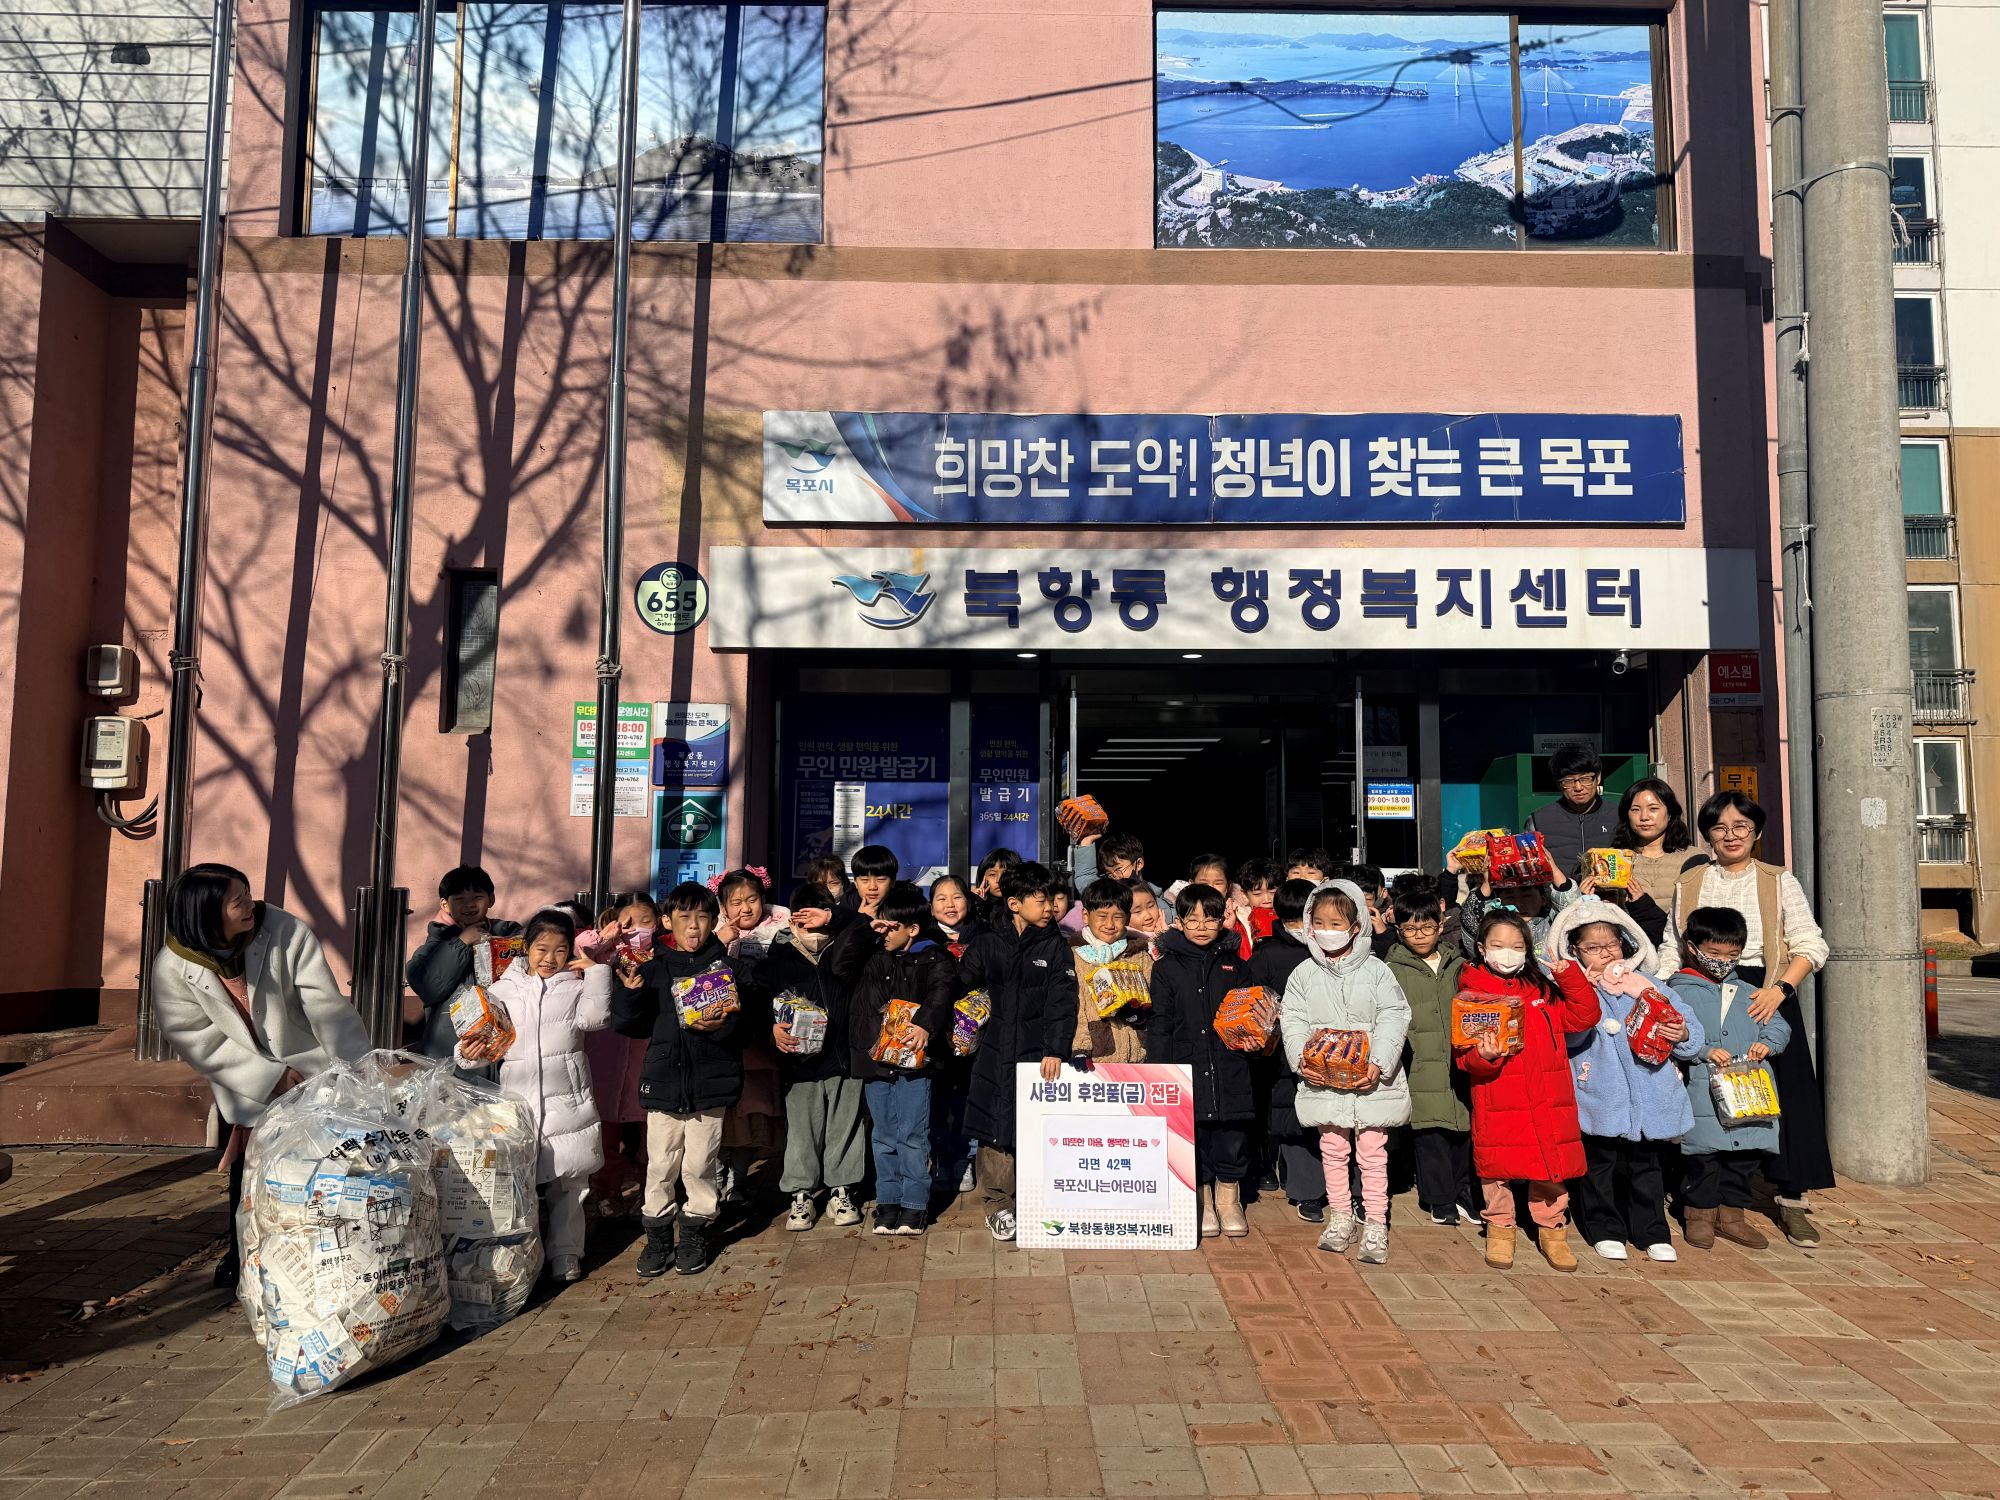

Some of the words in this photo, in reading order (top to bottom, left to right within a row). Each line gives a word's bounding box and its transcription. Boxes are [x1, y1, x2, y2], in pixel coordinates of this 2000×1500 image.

[932, 437, 1075, 498] 희망찬
[1087, 438, 1198, 498] 도약!
[1210, 437, 1351, 498] 청년이
[1367, 437, 1461, 498] 찾는
[1478, 438, 1524, 498] 큰
[1538, 438, 1634, 498] 목포
[785, 478, 835, 494] 목포시
[646, 591, 698, 613] 655
[964, 566, 1168, 633] 북항동
[1210, 566, 1643, 634] 행정복지센터
[1717, 664, 1753, 680] 에스원
[617, 722, 645, 733] 18:00
[865, 802, 913, 820] 24시간
[978, 811, 1002, 822] 365일
[1003, 811, 1030, 822] 24시간
[1461, 1011, 1501, 1024] 삼양라면
[1029, 1081, 1072, 1103] 사랑의
[1077, 1081, 1146, 1104] 후원품(금)
[1150, 1083, 1181, 1105] 전달
[1062, 1137, 1085, 1147] 따뜻한
[1107, 1137, 1130, 1148] 행복한
[1132, 1138, 1148, 1148] 나눔
[1077, 1158, 1101, 1171] 라면
[1106, 1158, 1132, 1171] 42팩
[1053, 1178, 1157, 1194] 목포신나는어린이집
[1067, 1222, 1174, 1237] 북항동행정복지센터
